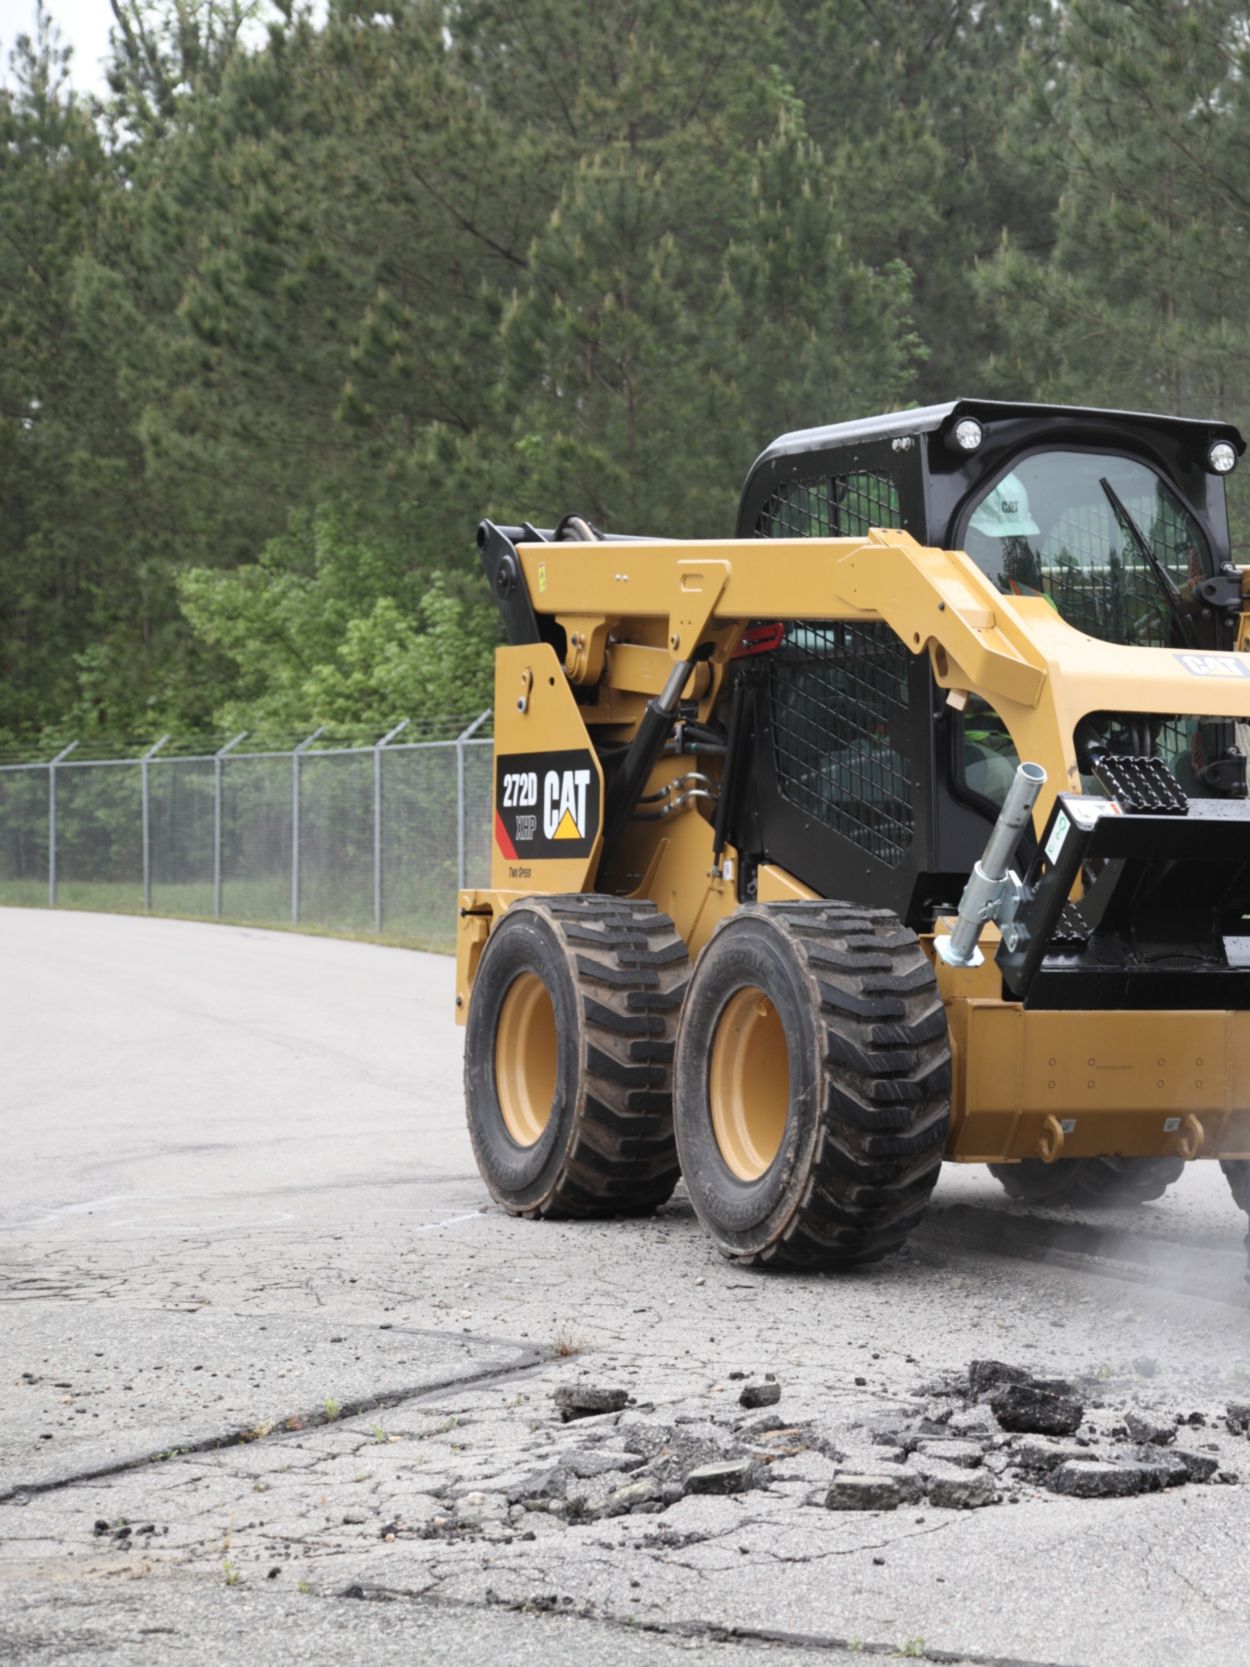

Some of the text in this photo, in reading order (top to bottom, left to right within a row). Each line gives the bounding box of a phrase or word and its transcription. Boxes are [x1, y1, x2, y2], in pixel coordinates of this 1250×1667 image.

[1001, 500, 1018, 513] CAT
[1181, 655, 1245, 677] CAT
[503, 772, 538, 807] 272D
[543, 769, 590, 840] CAT
